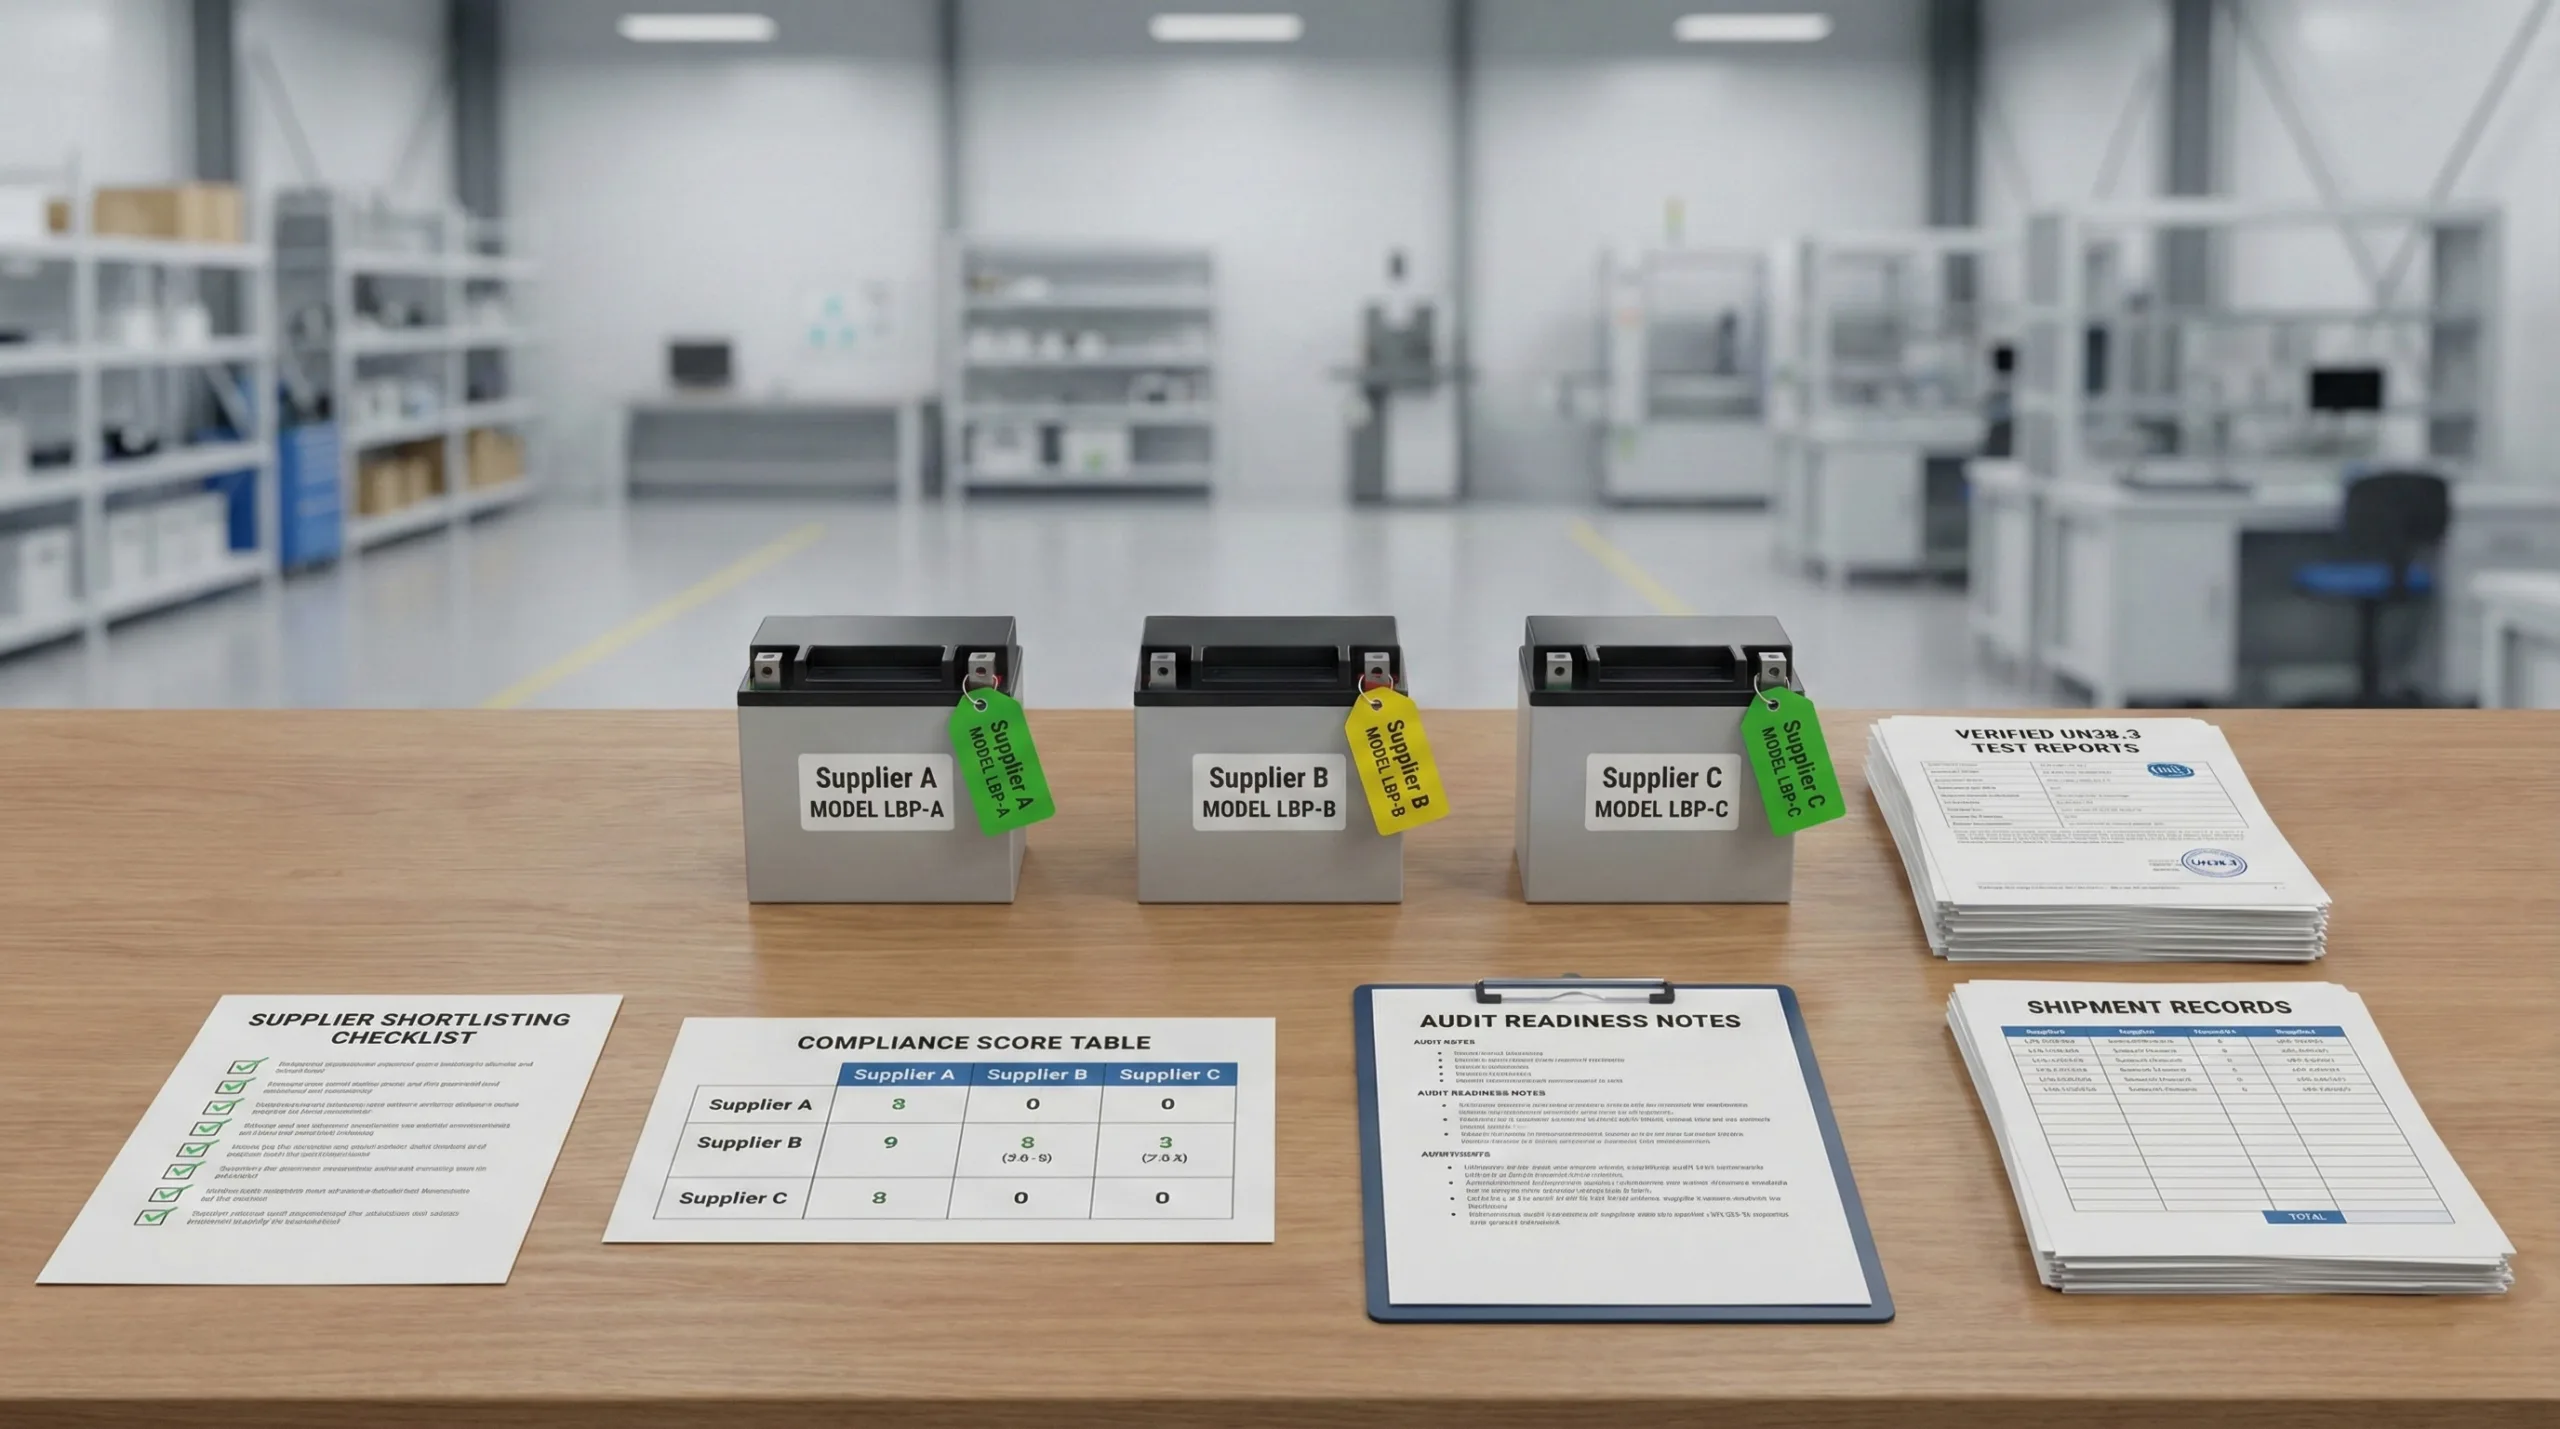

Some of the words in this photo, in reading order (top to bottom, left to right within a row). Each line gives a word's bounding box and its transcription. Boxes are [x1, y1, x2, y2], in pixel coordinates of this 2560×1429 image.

[1954, 729, 2055, 740] VERIFIED
[1971, 743, 2027, 754] TEST
[2034, 743, 2140, 754] REPORTS
[969, 726, 995, 775] MODEL
[985, 775, 1011, 818] LBP-A
[991, 720, 1026, 791] Supplier
[1015, 797, 1034, 810] A
[1365, 726, 1391, 774] MODEL
[1382, 775, 1406, 818] LBP-B
[1387, 720, 1422, 791] Supplier
[1411, 795, 1430, 809] B
[1762, 726, 1786, 775] MODEL
[1777, 775, 1801, 818] LBP-C
[1783, 720, 1817, 791] Supplier
[1807, 794, 1826, 809] C
[816, 765, 914, 795] Supplier
[919, 766, 938, 789] A
[1209, 765, 1306, 794] Supplier
[1313, 766, 1329, 788] B
[1602, 765, 1700, 794] Supplier
[1706, 766, 1723, 789] C
[810, 799, 879, 818] MODEL
[884, 800, 945, 818] LBP-A
[1202, 799, 1272, 818] MODEL
[1277, 799, 1336, 818] LBP-B
[1595, 799, 1663, 818] MODEL
[1669, 799, 1729, 818] LBP-C
[2027, 1000, 2162, 1014] SHIPMENT
[2169, 1000, 2293, 1014] RECORDS
[248, 1012, 375, 1027] SUPPLIER
[380, 1012, 571, 1027] SHORTLISTING
[1419, 1014, 1498, 1028] AUDIT
[1505, 1014, 1649, 1028] READINESS
[1656, 1014, 1742, 1028] NOTES
[331, 1030, 478, 1045] CHECKLIST
[797, 1035, 970, 1050] COMPLIANCE
[976, 1035, 1063, 1050] SCORE
[1070, 1035, 1151, 1050] TABLE
[854, 1068, 936, 1084] Supplier
[940, 1068, 955, 1081] A
[987, 1068, 1069, 1084] Supplier
[1074, 1068, 1088, 1081] B
[1119, 1068, 1201, 1084] Supplier
[1206, 1068, 1221, 1081] C
[1511, 1089, 1546, 1097] NOTES
[708, 1098, 793, 1114] Supplier
[797, 1098, 813, 1111] A
[1026, 1097, 1041, 1111] 0
[1161, 1097, 1175, 1110] 0
[697, 1135, 783, 1152] Supplier
[787, 1136, 803, 1149] B
[883, 1136, 898, 1149] 9
[1020, 1136, 1035, 1149] 8
[679, 1191, 768, 1208] Supplier
[772, 1191, 788, 1205] C
[872, 1191, 887, 1205] 8
[1014, 1191, 1029, 1205] 0
[1155, 1191, 1170, 1205] 0
[2287, 1212, 2328, 1221] TOTAL
